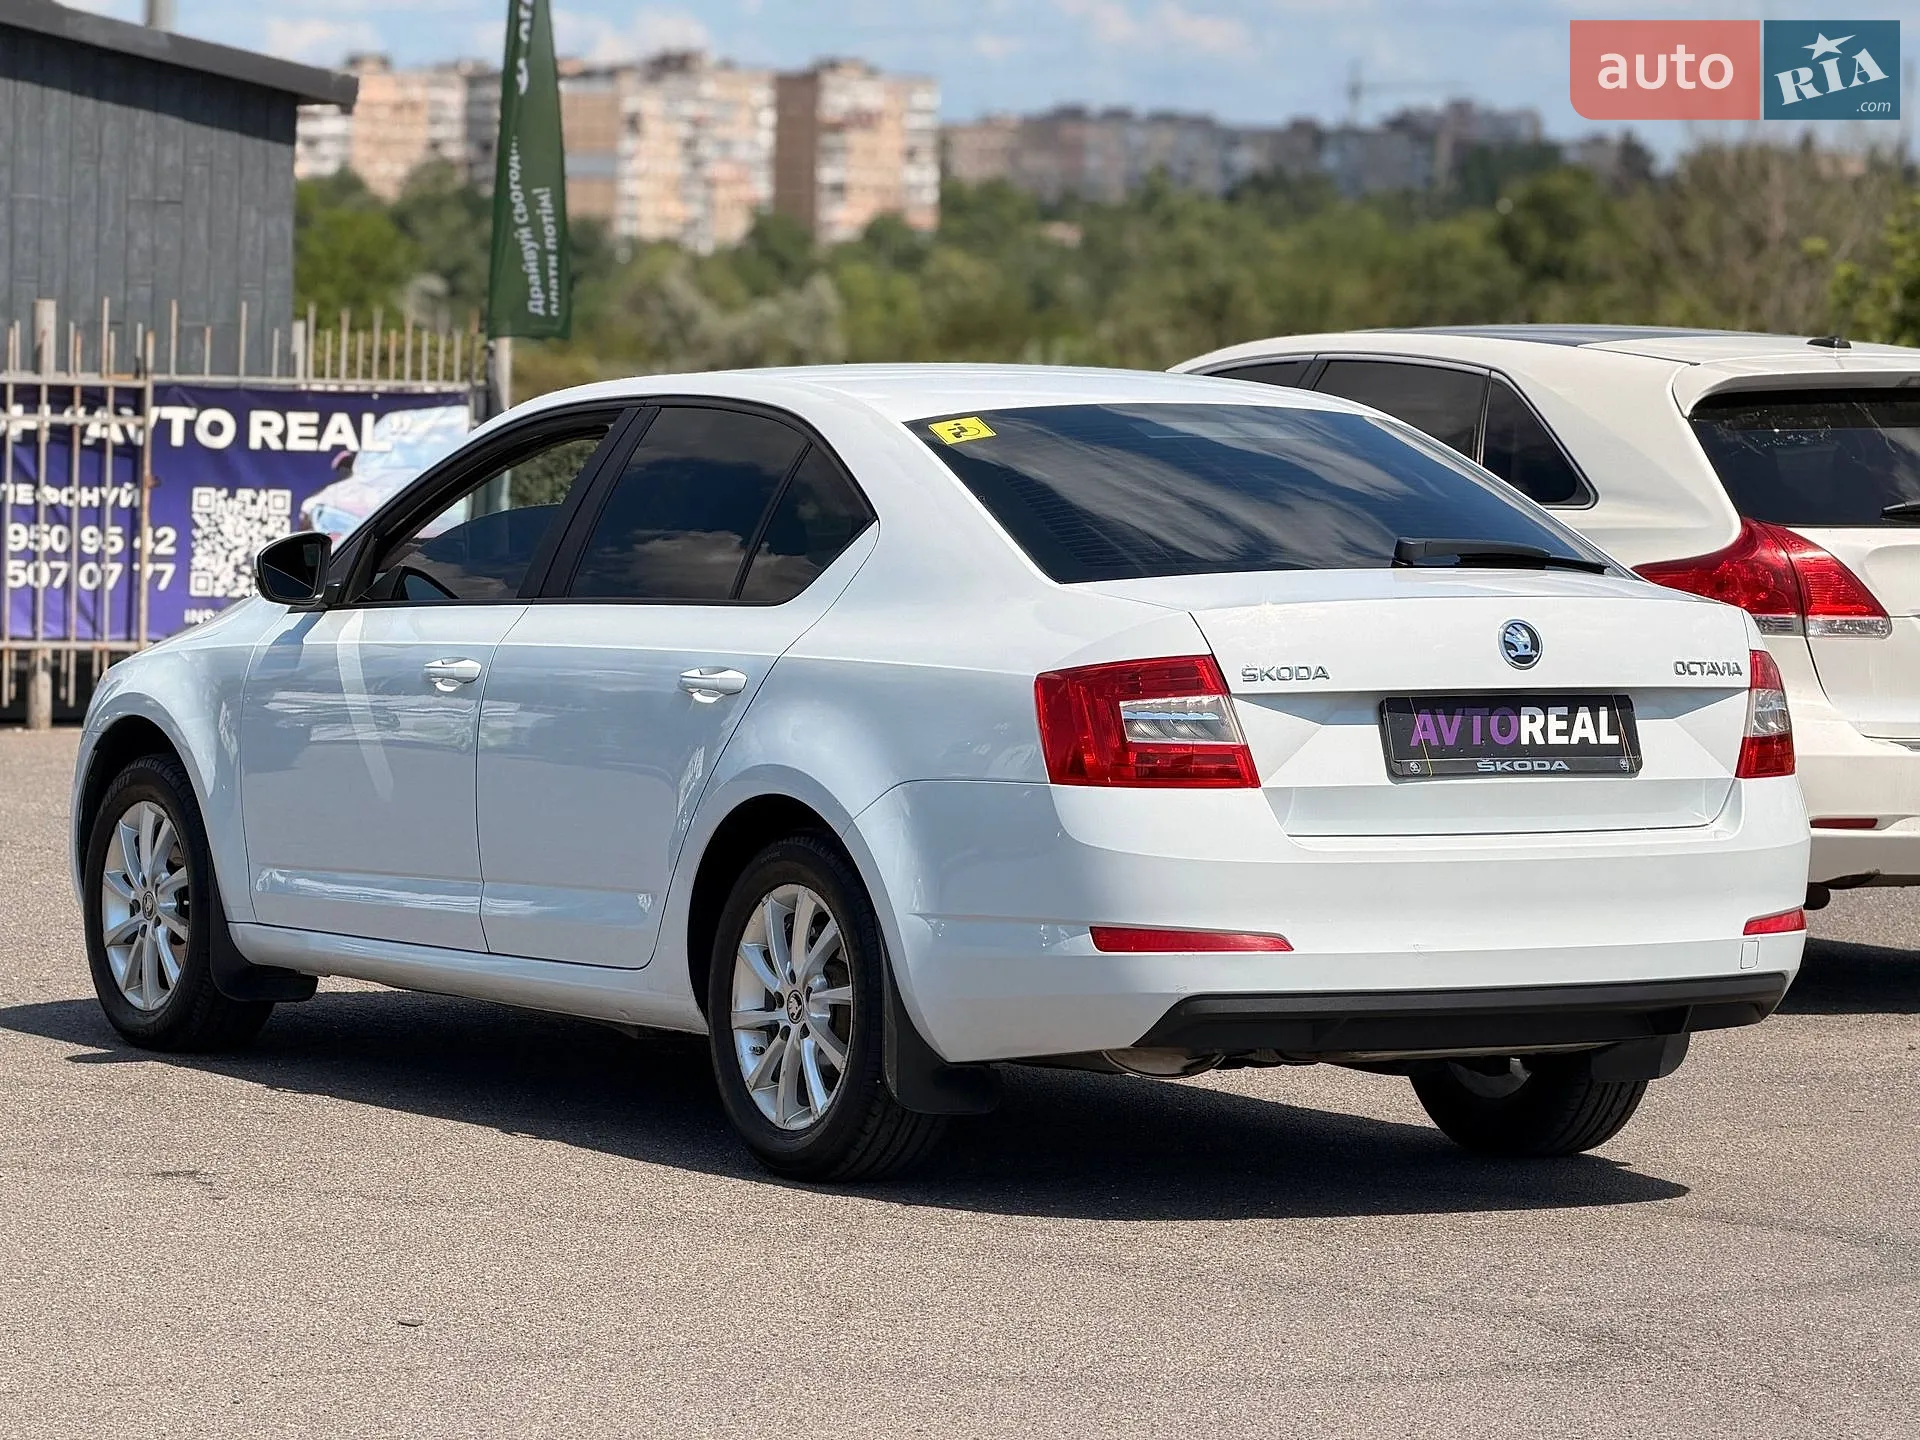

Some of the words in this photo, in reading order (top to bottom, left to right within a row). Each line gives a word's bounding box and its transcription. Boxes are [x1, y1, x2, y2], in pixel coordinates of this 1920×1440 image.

[532, 187, 558, 251] потім!
[513, 226, 545, 317] Драйвуй
[7, 523, 71, 553] 950
[80, 525, 124, 555] 95
[6, 559, 70, 589] 507
[78, 562, 123, 591] 07
[1241, 663, 1330, 682] ŠKODA
[1673, 661, 1743, 677] OCTAVIA
[1409, 705, 1620, 747] AVTOREAL
[1476, 758, 1571, 772] ŠKODA
